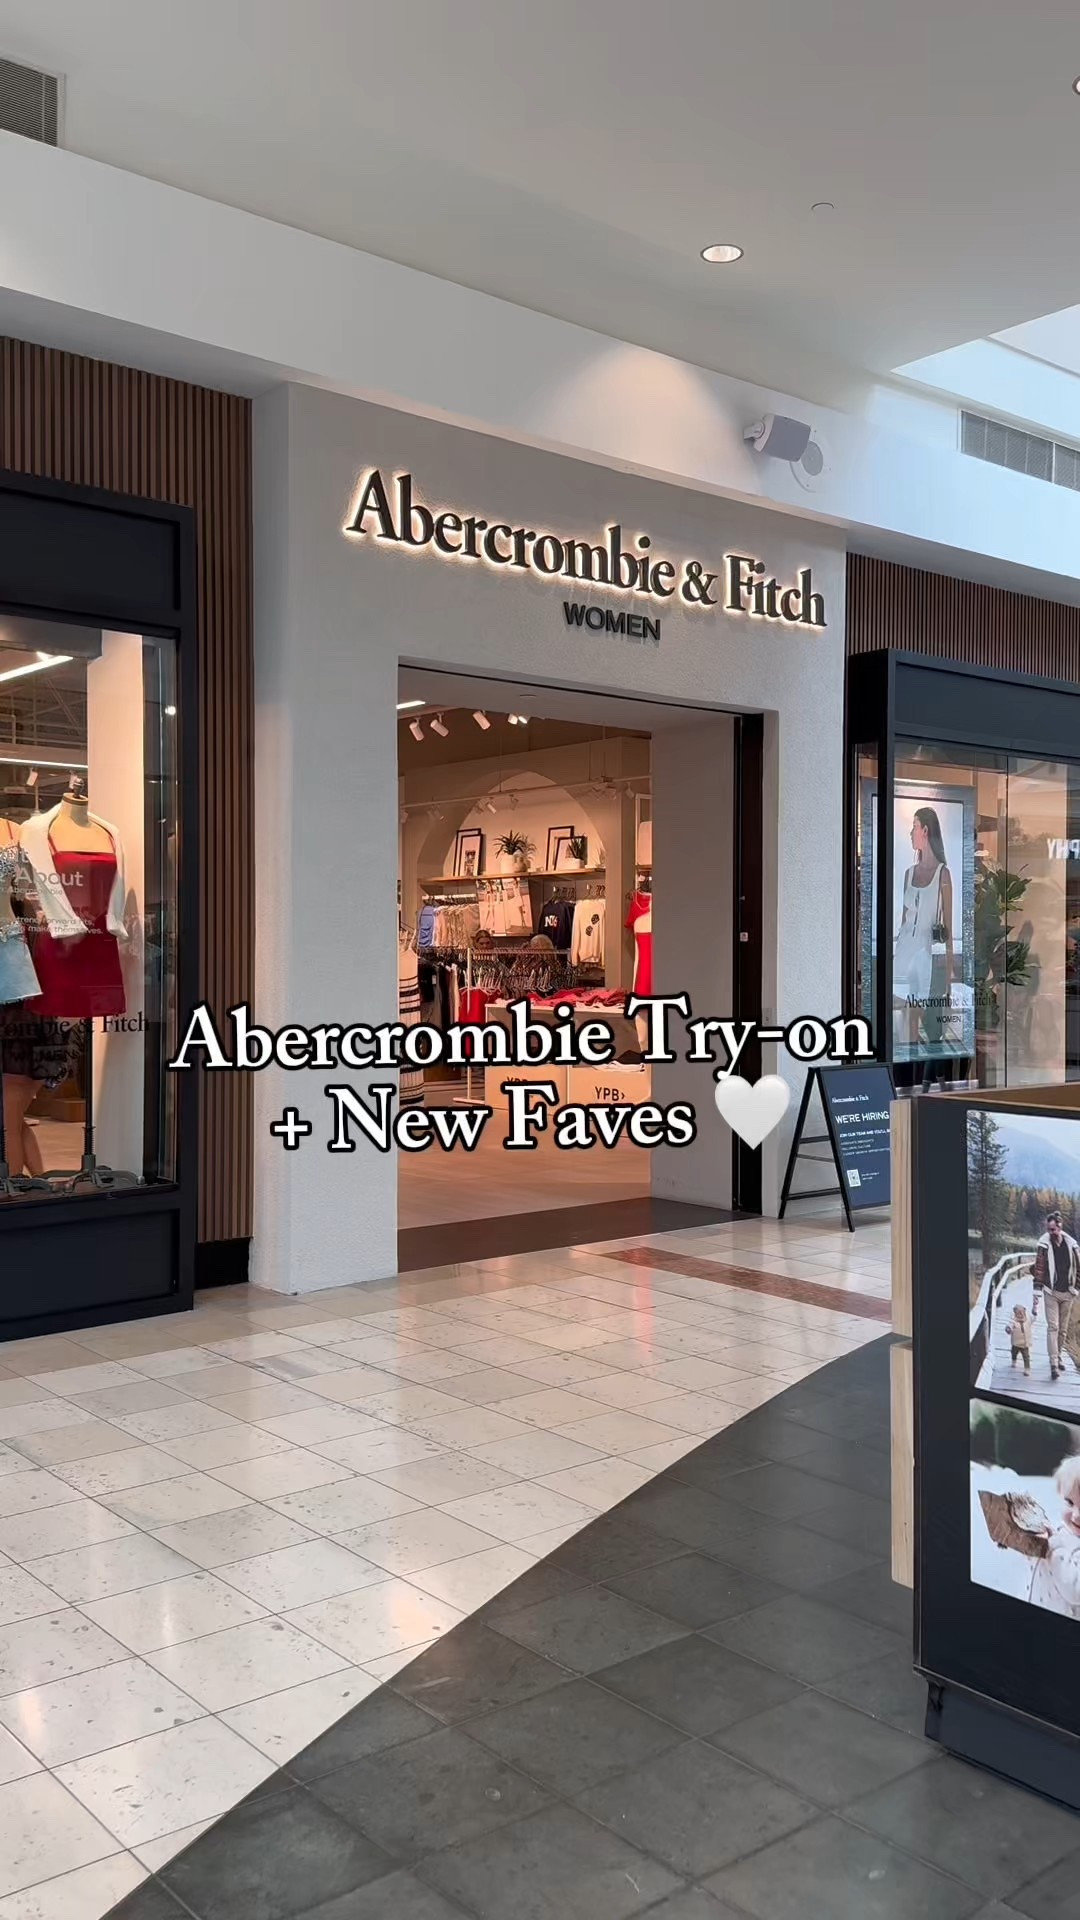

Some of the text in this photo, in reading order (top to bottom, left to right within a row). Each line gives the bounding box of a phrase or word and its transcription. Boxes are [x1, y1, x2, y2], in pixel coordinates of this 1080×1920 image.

[346, 469, 828, 627] Abercrombie & Fitch
[563, 601, 661, 641] WOMEN
[904, 993, 960, 1008] Abercrombie
[101, 1010, 150, 1033] Fitch
[936, 1015, 962, 1024] WOMEN
[835, 1110, 890, 1124] WE'RE HIRING
